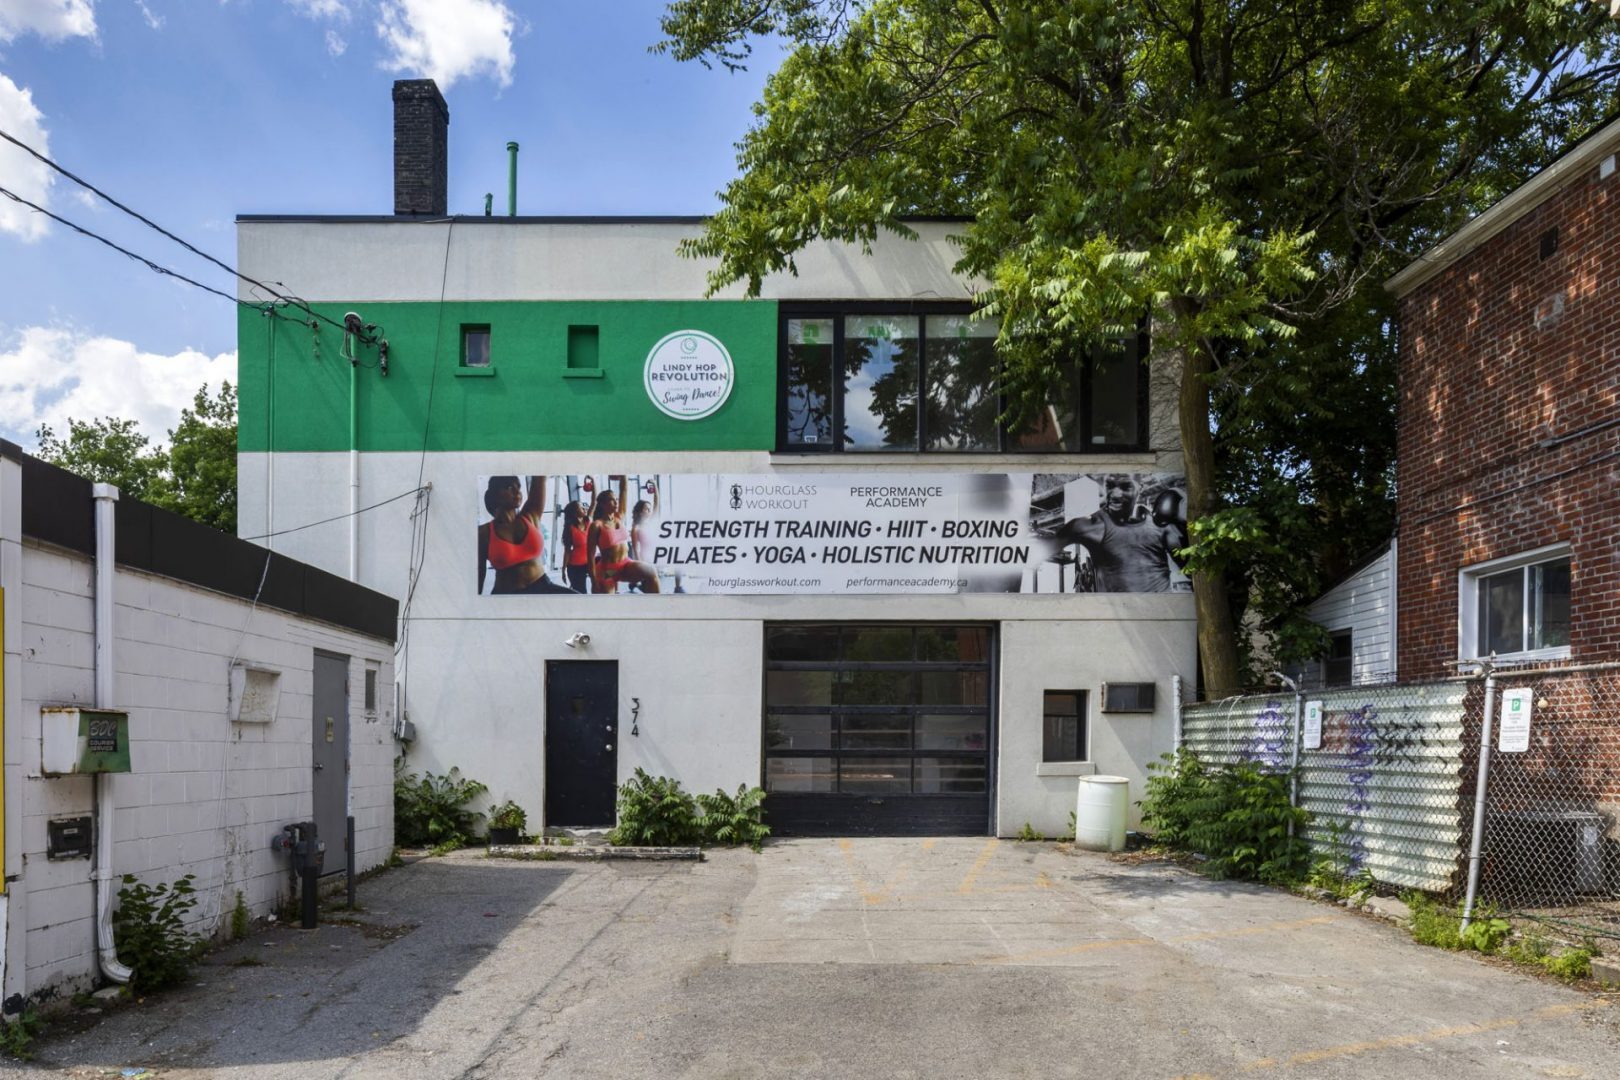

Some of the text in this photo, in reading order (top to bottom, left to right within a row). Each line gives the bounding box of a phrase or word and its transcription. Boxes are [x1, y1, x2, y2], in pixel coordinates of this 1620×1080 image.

[663, 364, 717, 372] LINDY HOP
[652, 372, 727, 381] REVOLUTION
[663, 386, 721, 405] Swing Dance!
[745, 485, 817, 496] HOURGLASS
[850, 487, 943, 497] PERFORMANCE
[745, 499, 808, 510] WORKOUT
[866, 498, 927, 508] ACADEMY
[658, 520, 1019, 539] STRENGTH TRAINING HIIT BOXING
[653, 546, 1030, 564] PILATES YOGA HOLISTIC NUTRITION
[708, 577, 821, 589] hourglassworkout.com
[846, 577, 968, 589] performanceacademy.ca
[631, 697, 640, 738] 374
